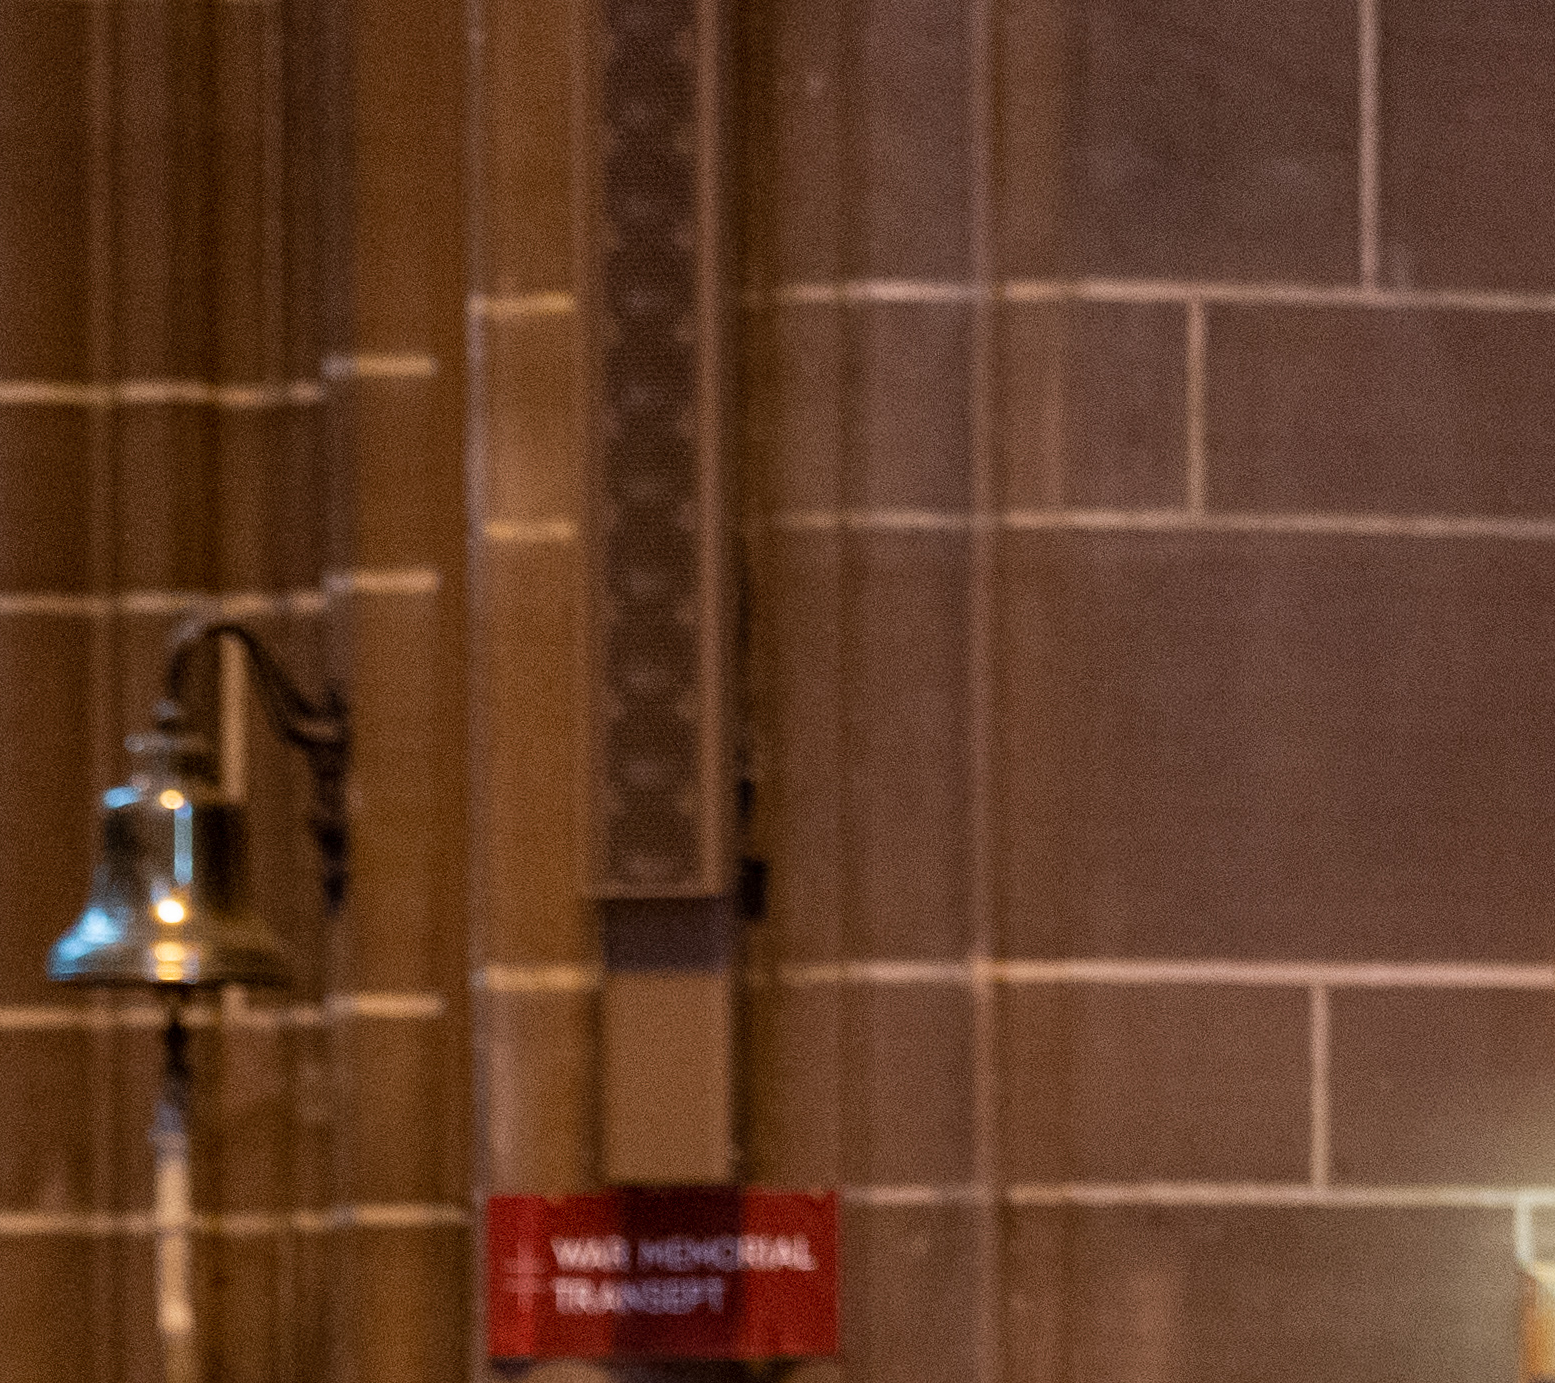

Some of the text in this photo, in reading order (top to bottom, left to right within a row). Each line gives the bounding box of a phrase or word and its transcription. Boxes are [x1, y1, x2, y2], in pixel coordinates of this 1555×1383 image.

[550, 1235, 815, 1272] WAR MEMORIAL
[551, 1277, 725, 1314] TRANSEPT
